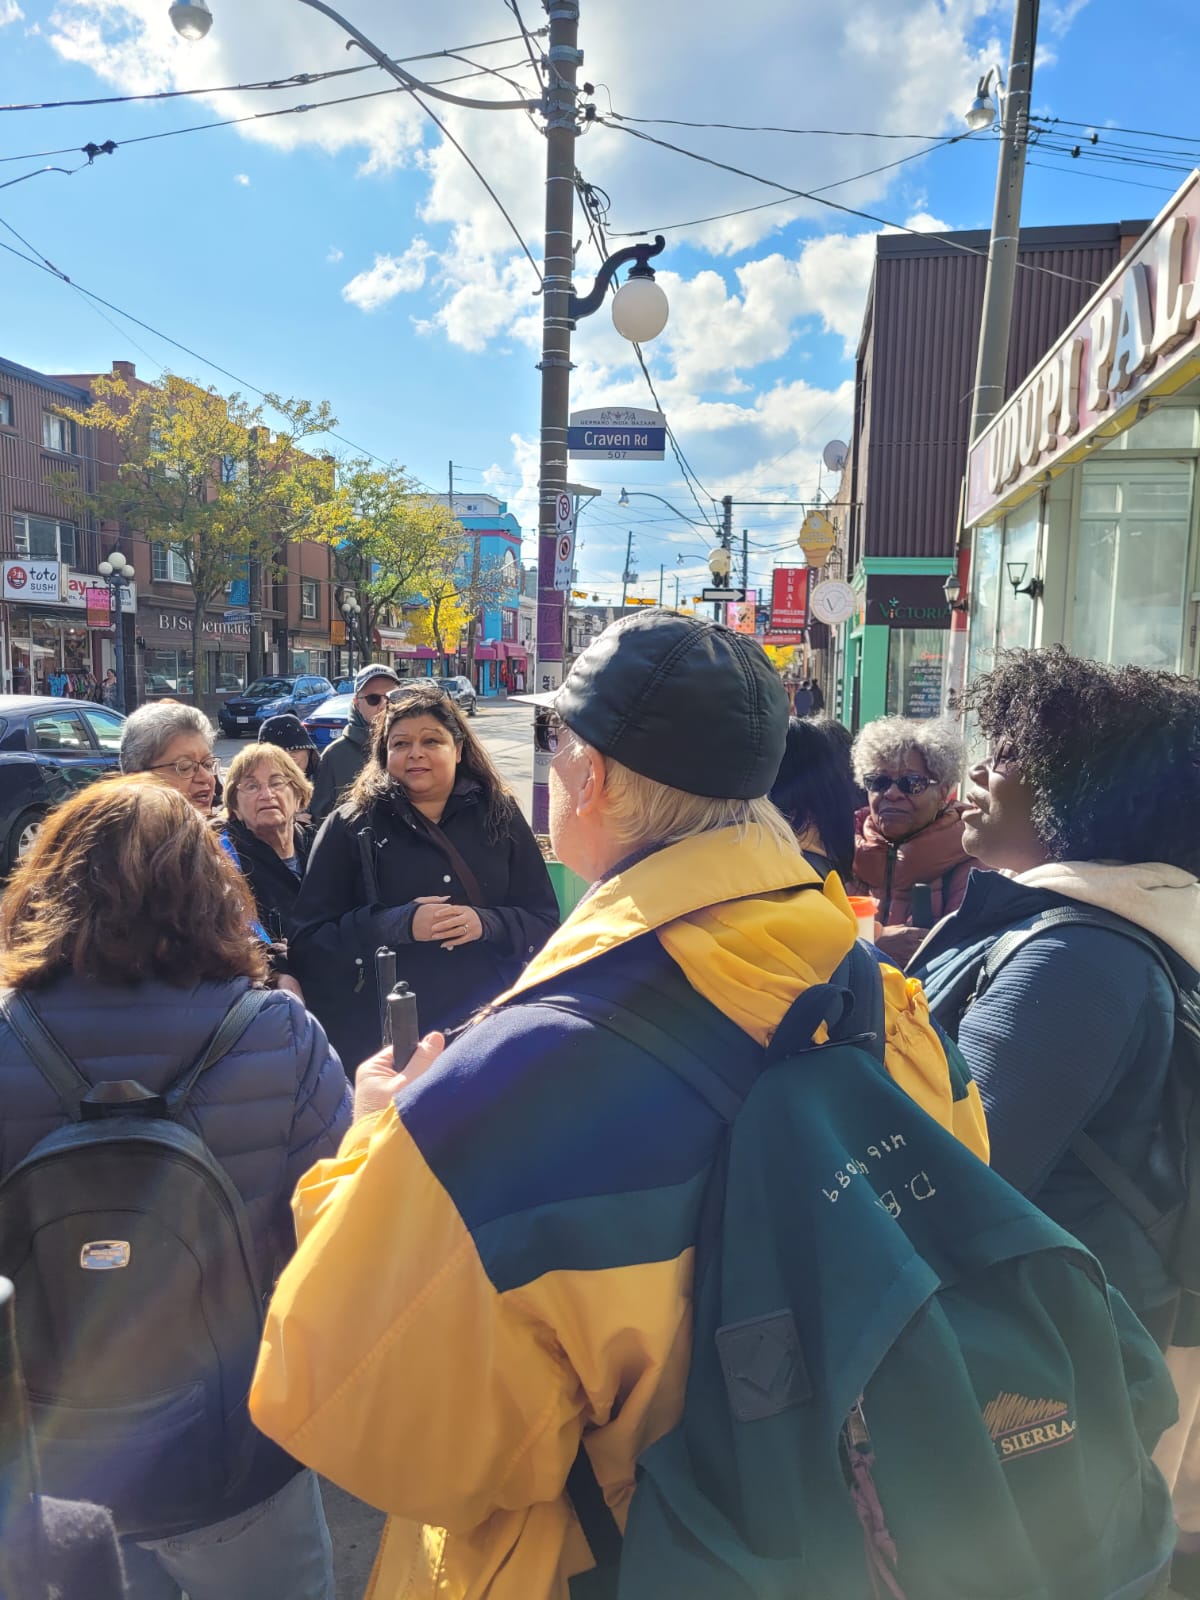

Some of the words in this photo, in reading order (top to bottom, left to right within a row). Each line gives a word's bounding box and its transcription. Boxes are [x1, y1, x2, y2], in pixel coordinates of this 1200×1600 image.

[988, 336, 1083, 496] UDUPI
[1087, 216, 1200, 411] PAL
[584, 431, 630, 446] Craven
[634, 433, 648, 446] Rd
[607, 451, 627, 459] 507
[29, 567, 57, 581] toto
[30, 583, 57, 591] SUSHI
[786, 570, 796, 608] DUBAI
[1000, 1419, 1073, 1455] SIERRA
